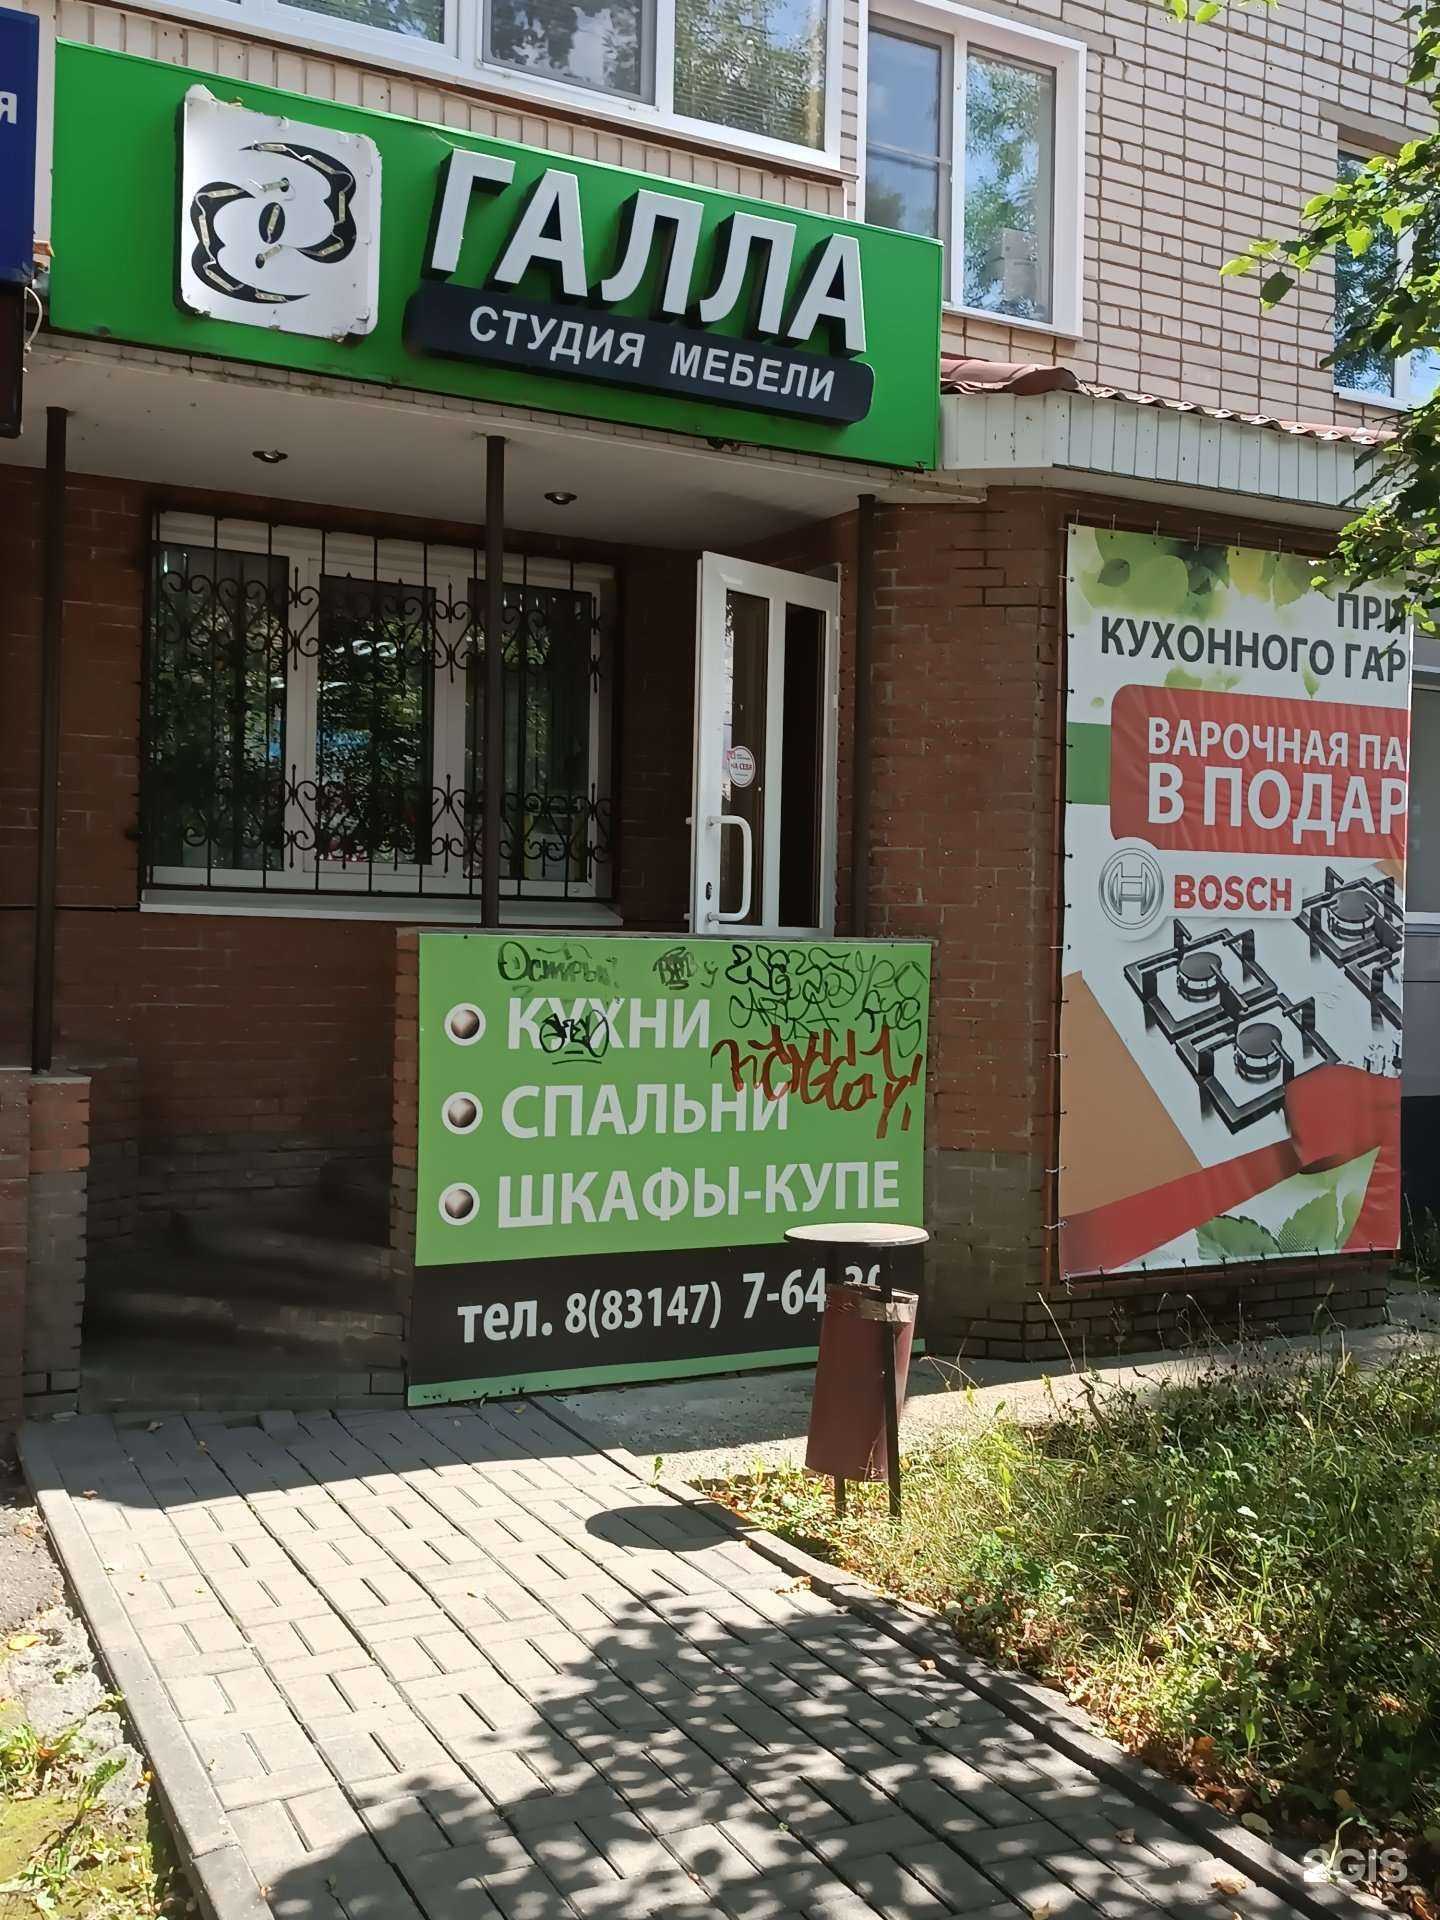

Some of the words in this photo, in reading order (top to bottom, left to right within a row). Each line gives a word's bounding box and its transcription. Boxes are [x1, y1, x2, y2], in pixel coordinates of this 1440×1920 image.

[431, 148, 867, 354] ГАЛЛА
[470, 305, 645, 368] СТУДИЯ
[669, 342, 836, 403] МЕБЕЛИ
[1101, 616, 1335, 676] КУХОННОГО
[1345, 643, 1406, 682] ГАР
[1148, 717, 1349, 768] ВАРОЧНАЯ
[1148, 762, 1185, 825] В
[1204, 766, 1408, 846] ПОДАР
[1174, 874, 1292, 911] BOSCH
[508, 998, 710, 1049] КУХНИ
[501, 1082, 789, 1139] СПАЛЬНИ
[498, 1160, 899, 1228] ШКАФЫ-КУПЕ
[457, 1300, 552, 1344] тел.
[565, 1281, 721, 1337] 8(83147)
